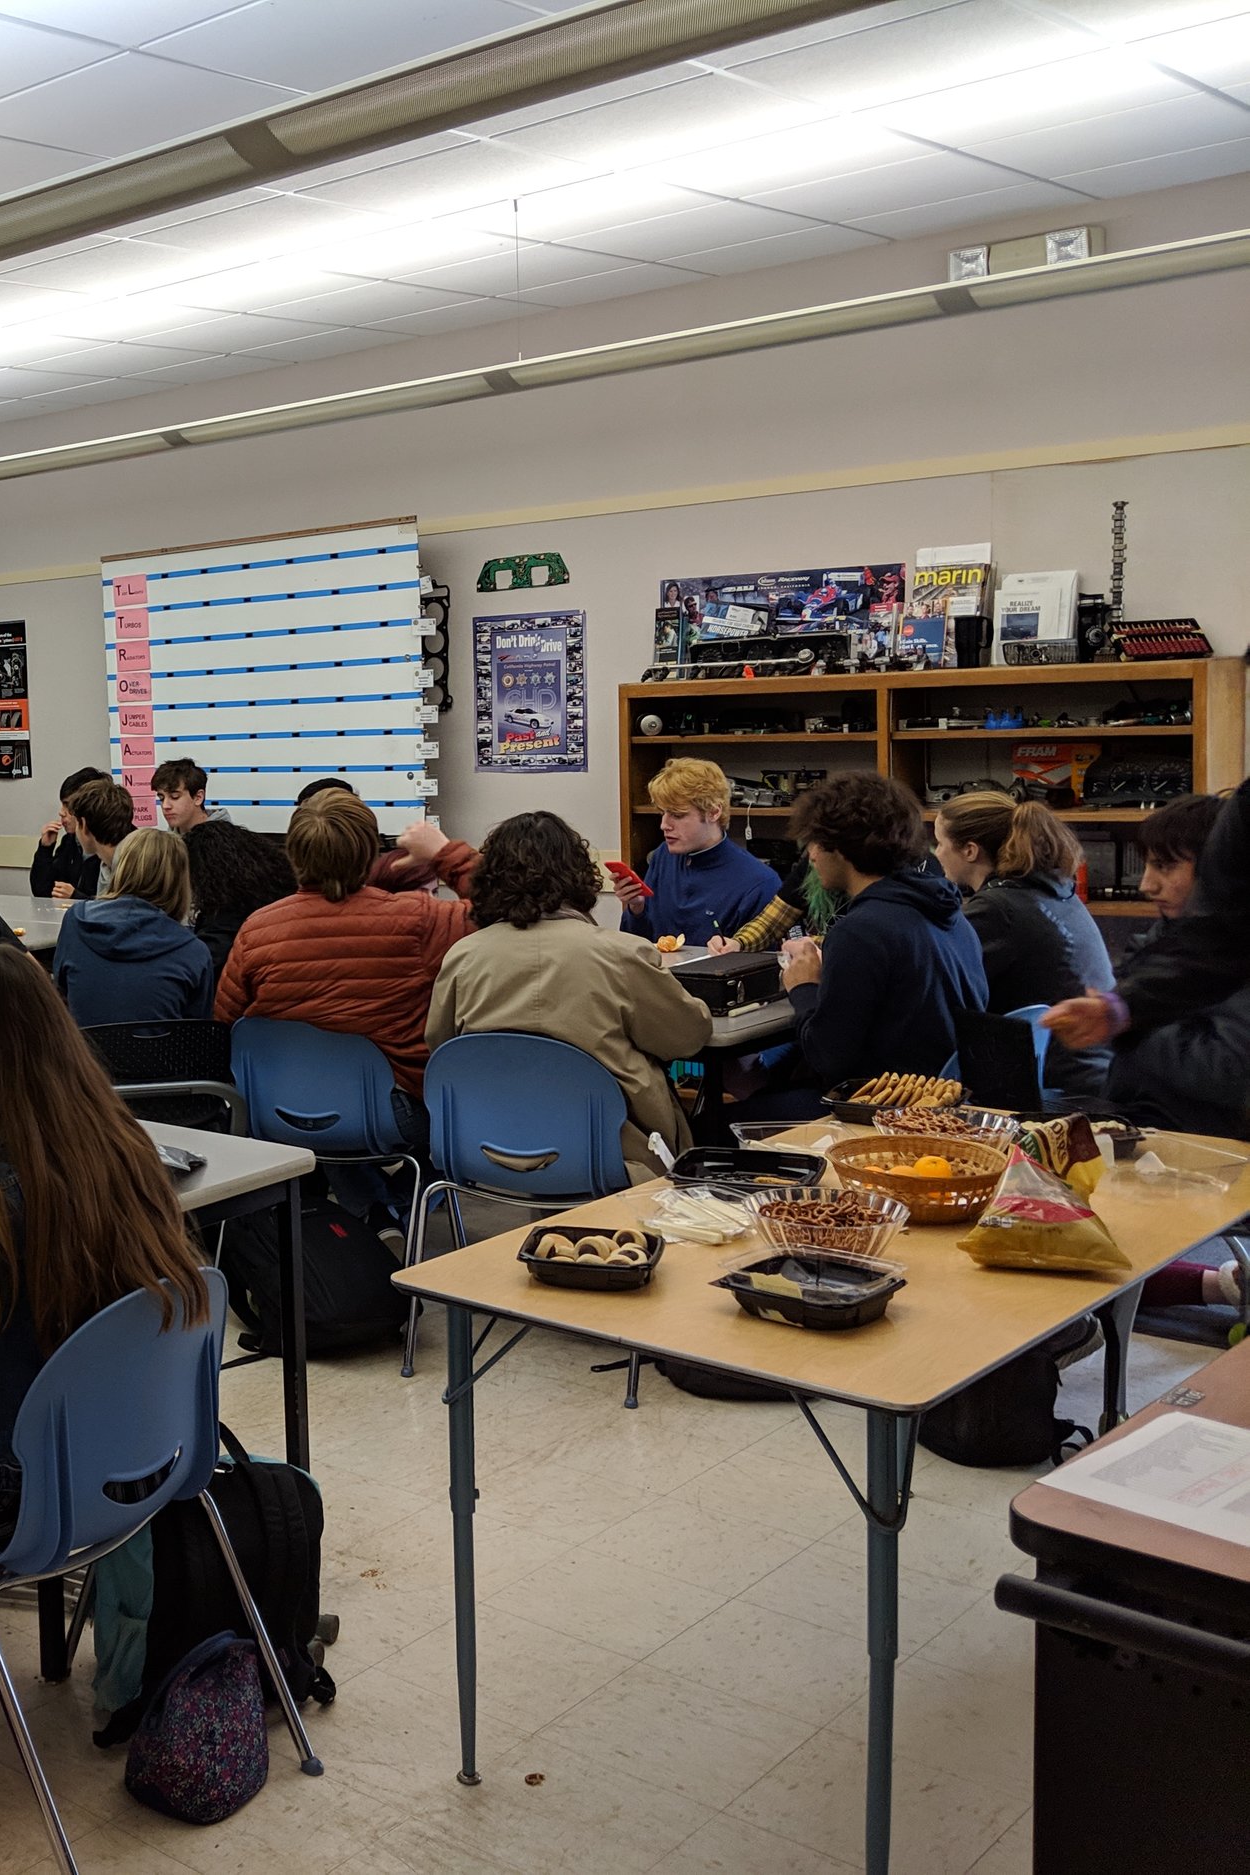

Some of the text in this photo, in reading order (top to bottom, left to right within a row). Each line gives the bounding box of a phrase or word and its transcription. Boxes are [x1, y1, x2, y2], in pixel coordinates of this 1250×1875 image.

[914, 567, 983, 587] marin
[117, 616, 142, 629] TURBOS
[707, 624, 749, 637] HORSEPOWER
[495, 635, 517, 649] Don't
[540, 639, 562, 653] Drive
[505, 730, 536, 743] Past
[498, 734, 561, 755] Present
[1016, 746, 1057, 757] FRAM
